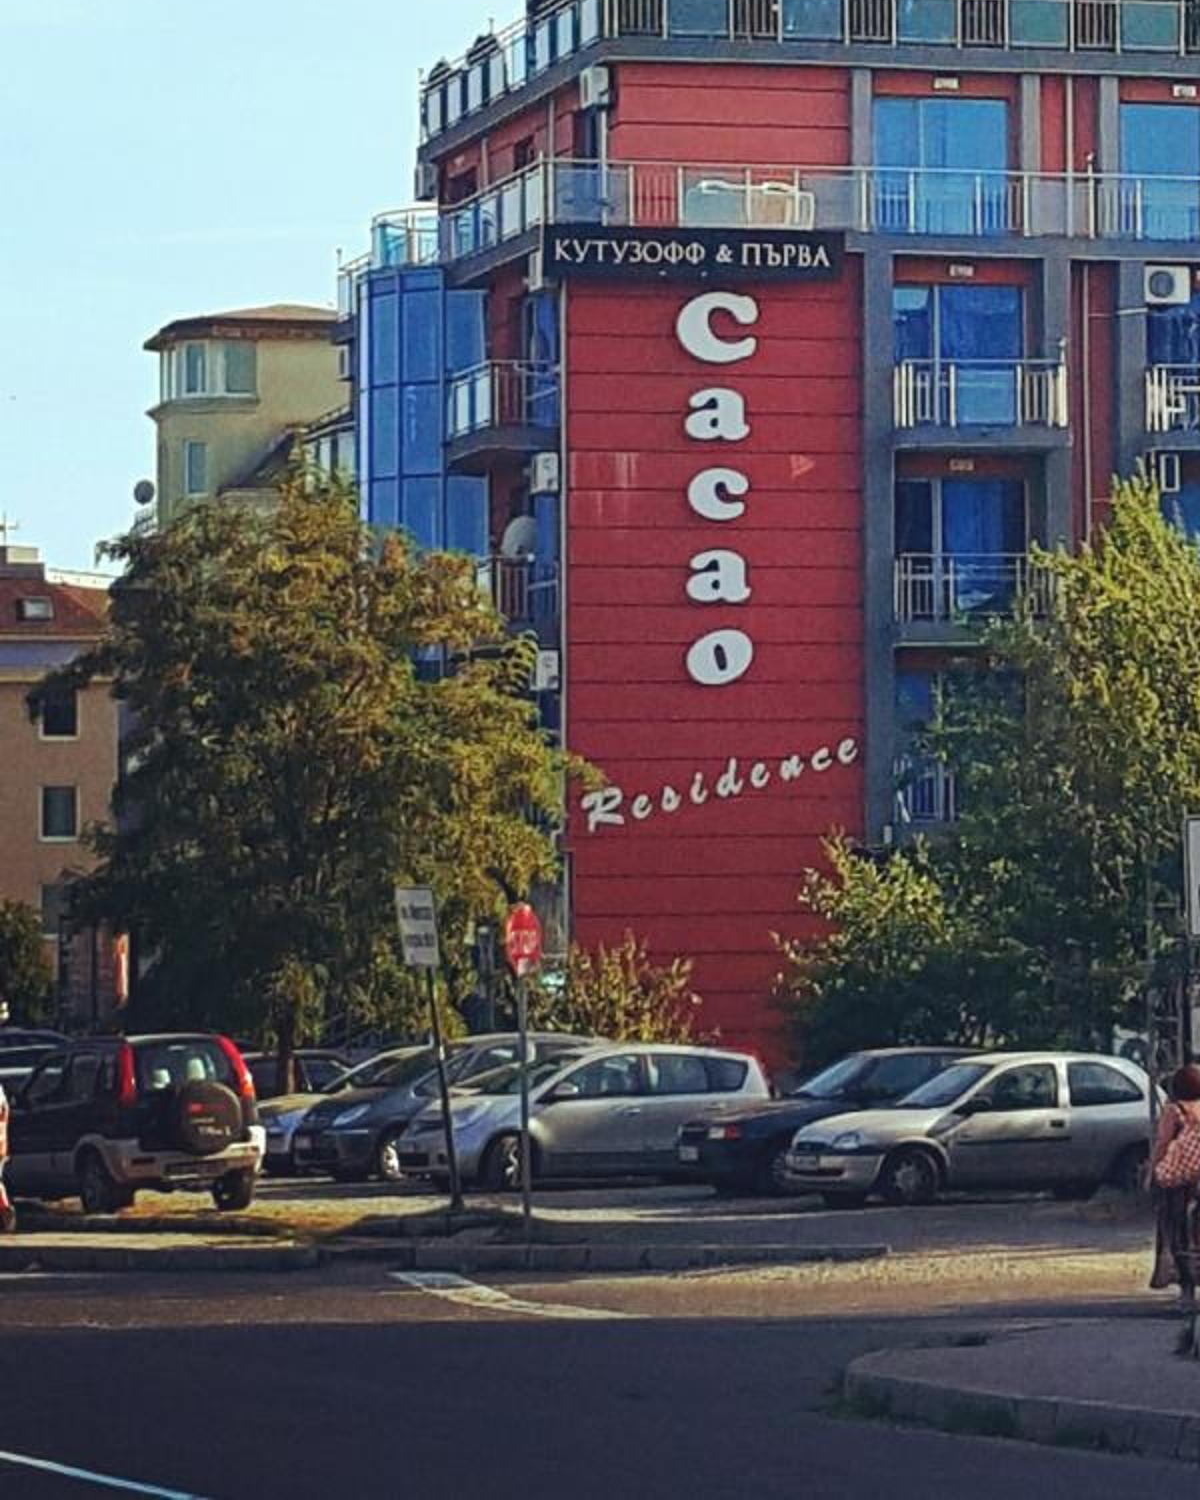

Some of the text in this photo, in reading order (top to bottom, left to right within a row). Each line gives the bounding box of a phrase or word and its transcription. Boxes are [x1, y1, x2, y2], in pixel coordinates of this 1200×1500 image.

[554, 238, 830, 268] КУТУЗОФФ & ПЪРВА
[675, 290, 758, 686] Cacao
[581, 737, 859, 834] Residence
